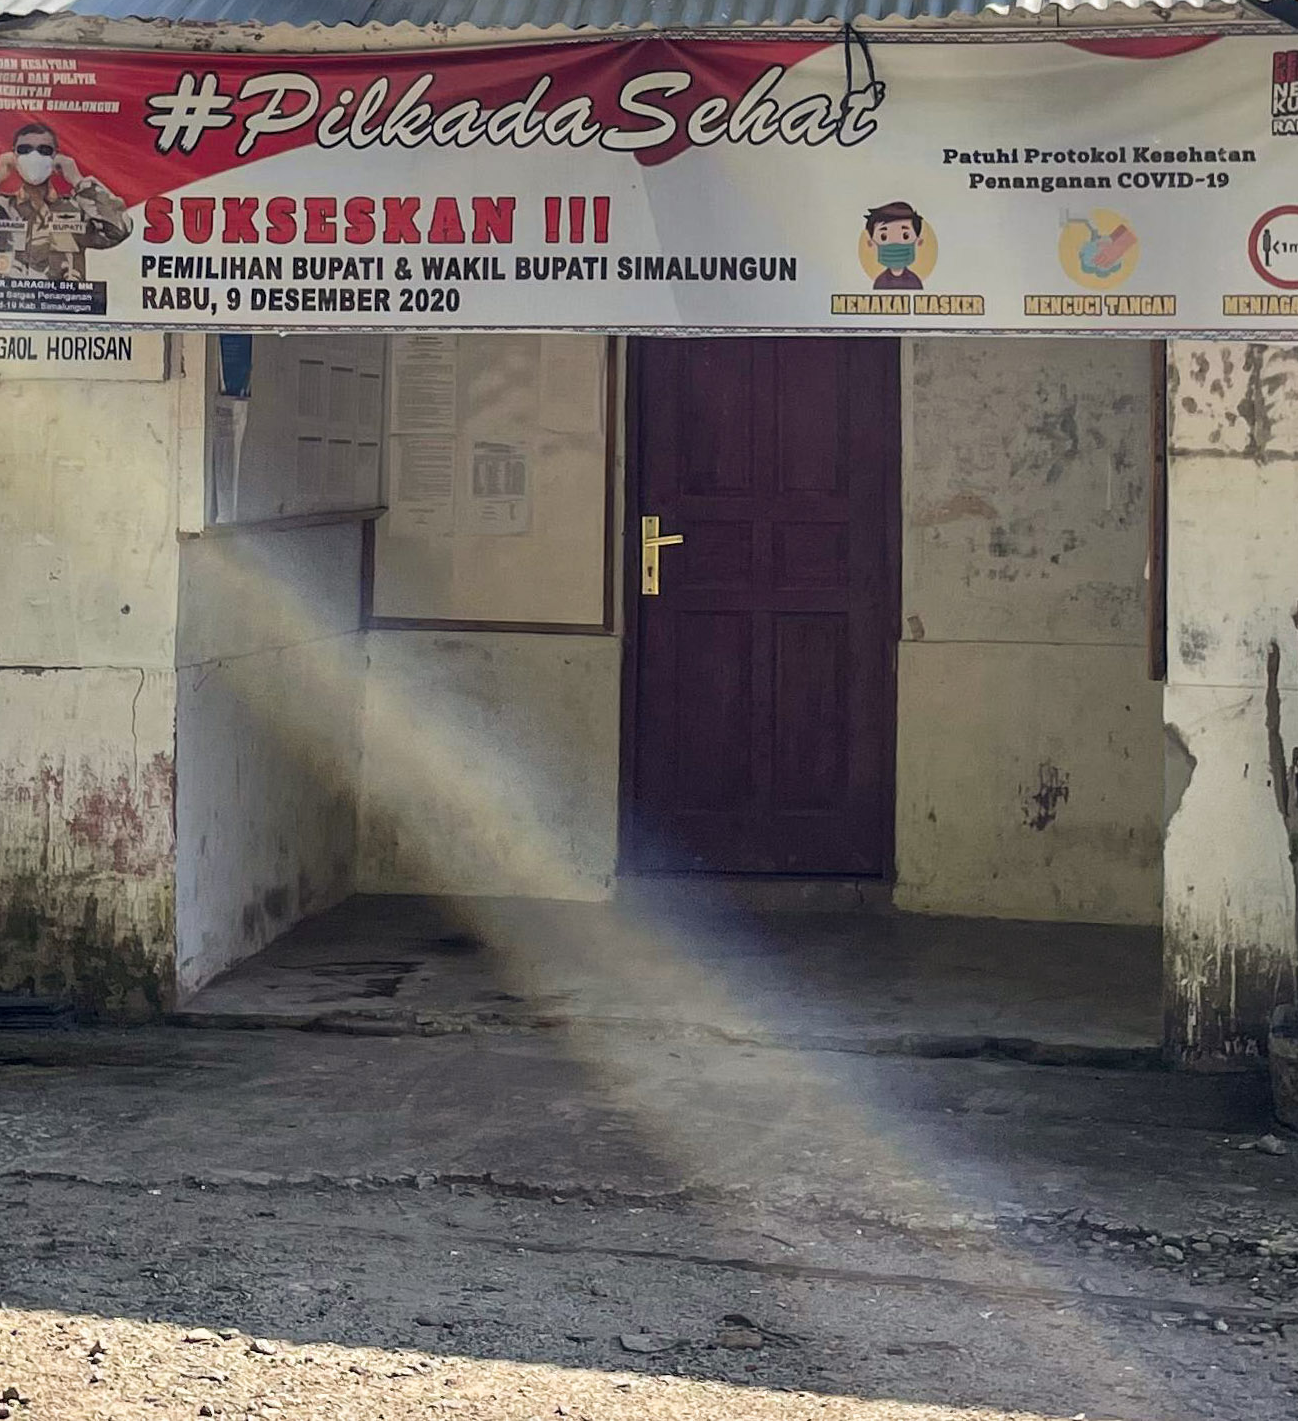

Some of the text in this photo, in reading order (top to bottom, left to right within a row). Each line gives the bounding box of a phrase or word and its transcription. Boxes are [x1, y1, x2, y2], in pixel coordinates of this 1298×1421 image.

[942, 146, 1257, 167] Patuhi Protokol Kesehatan
[968, 172, 1229, 194] Penanganan COVID-19
[142, 196, 611, 245] SUKSESKAN !!!
[141, 256, 798, 282] PEMILIHAN BUPATI & WAKIL BUPATI SIMALUNGUN
[141, 287, 460, 316] RABU, 9 DESEMBER 2020
[831, 294, 984, 315] MEMAKAI MASKER
[1025, 295, 1176, 315] MENCUCI TANGAN
[47, 336, 132, 361] HORISAN
